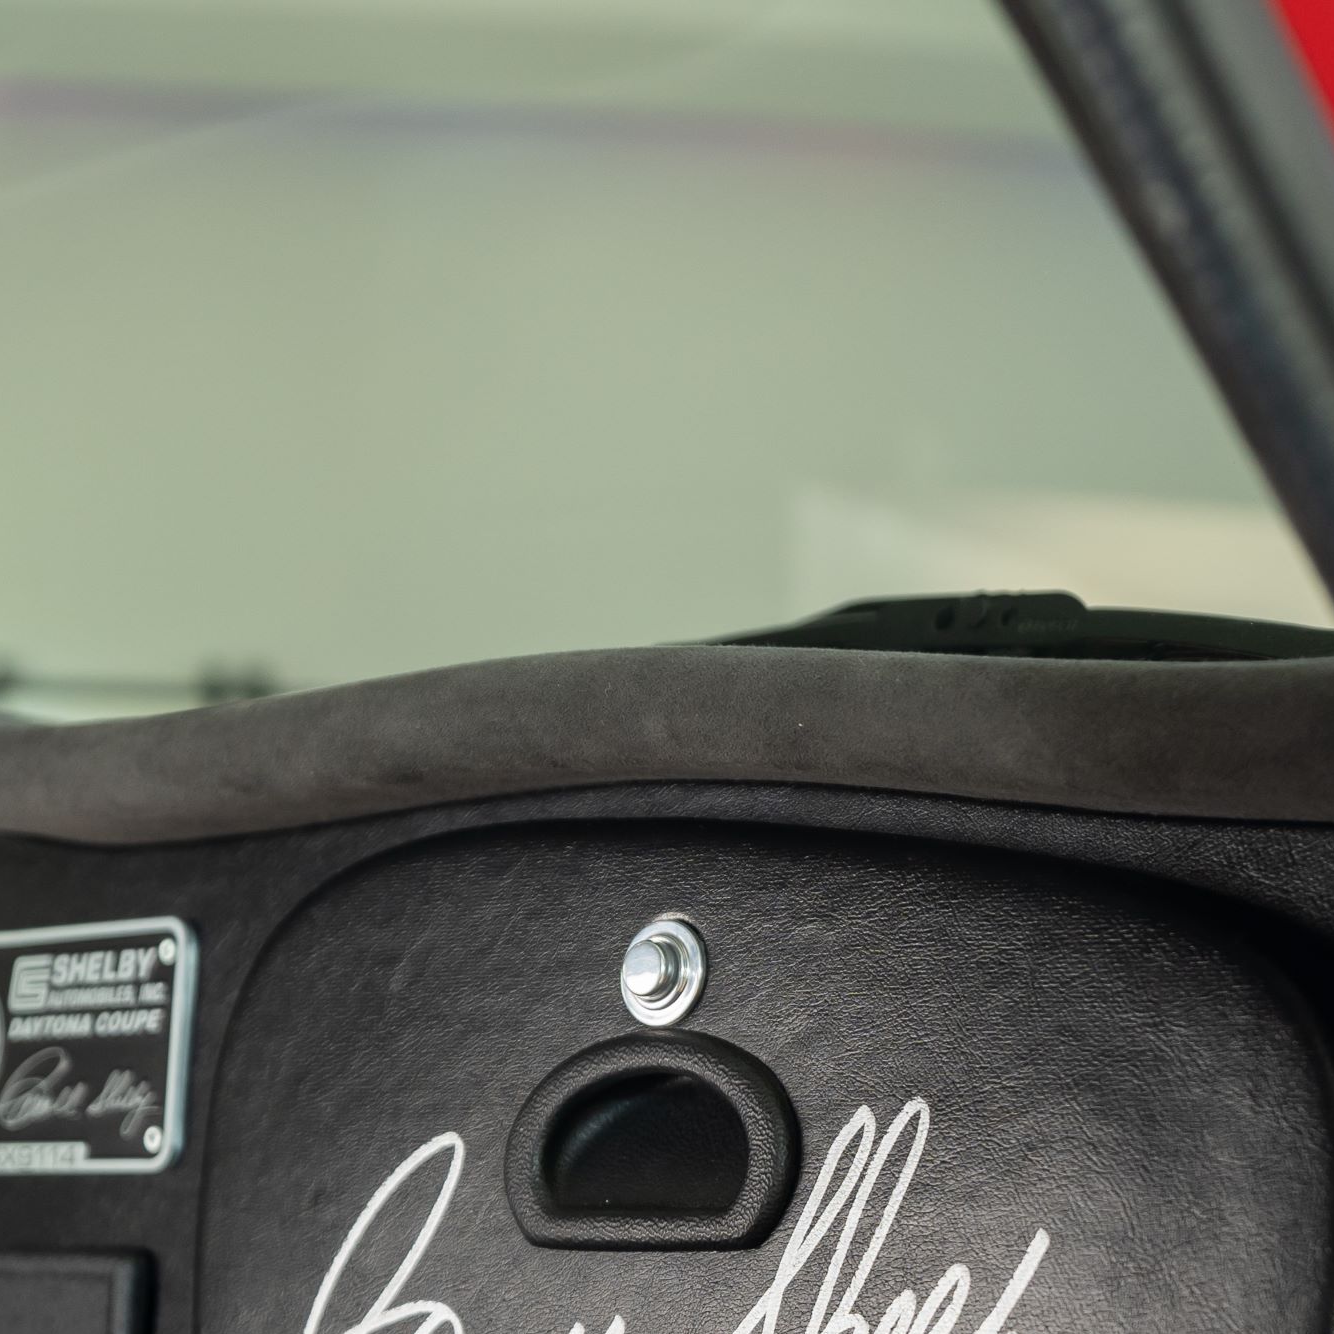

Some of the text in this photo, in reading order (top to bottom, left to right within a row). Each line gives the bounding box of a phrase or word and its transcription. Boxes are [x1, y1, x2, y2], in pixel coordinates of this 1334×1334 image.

[53, 947, 156, 985] SHELBY
[8, 1009, 163, 1040] DAYTONA COUPE
